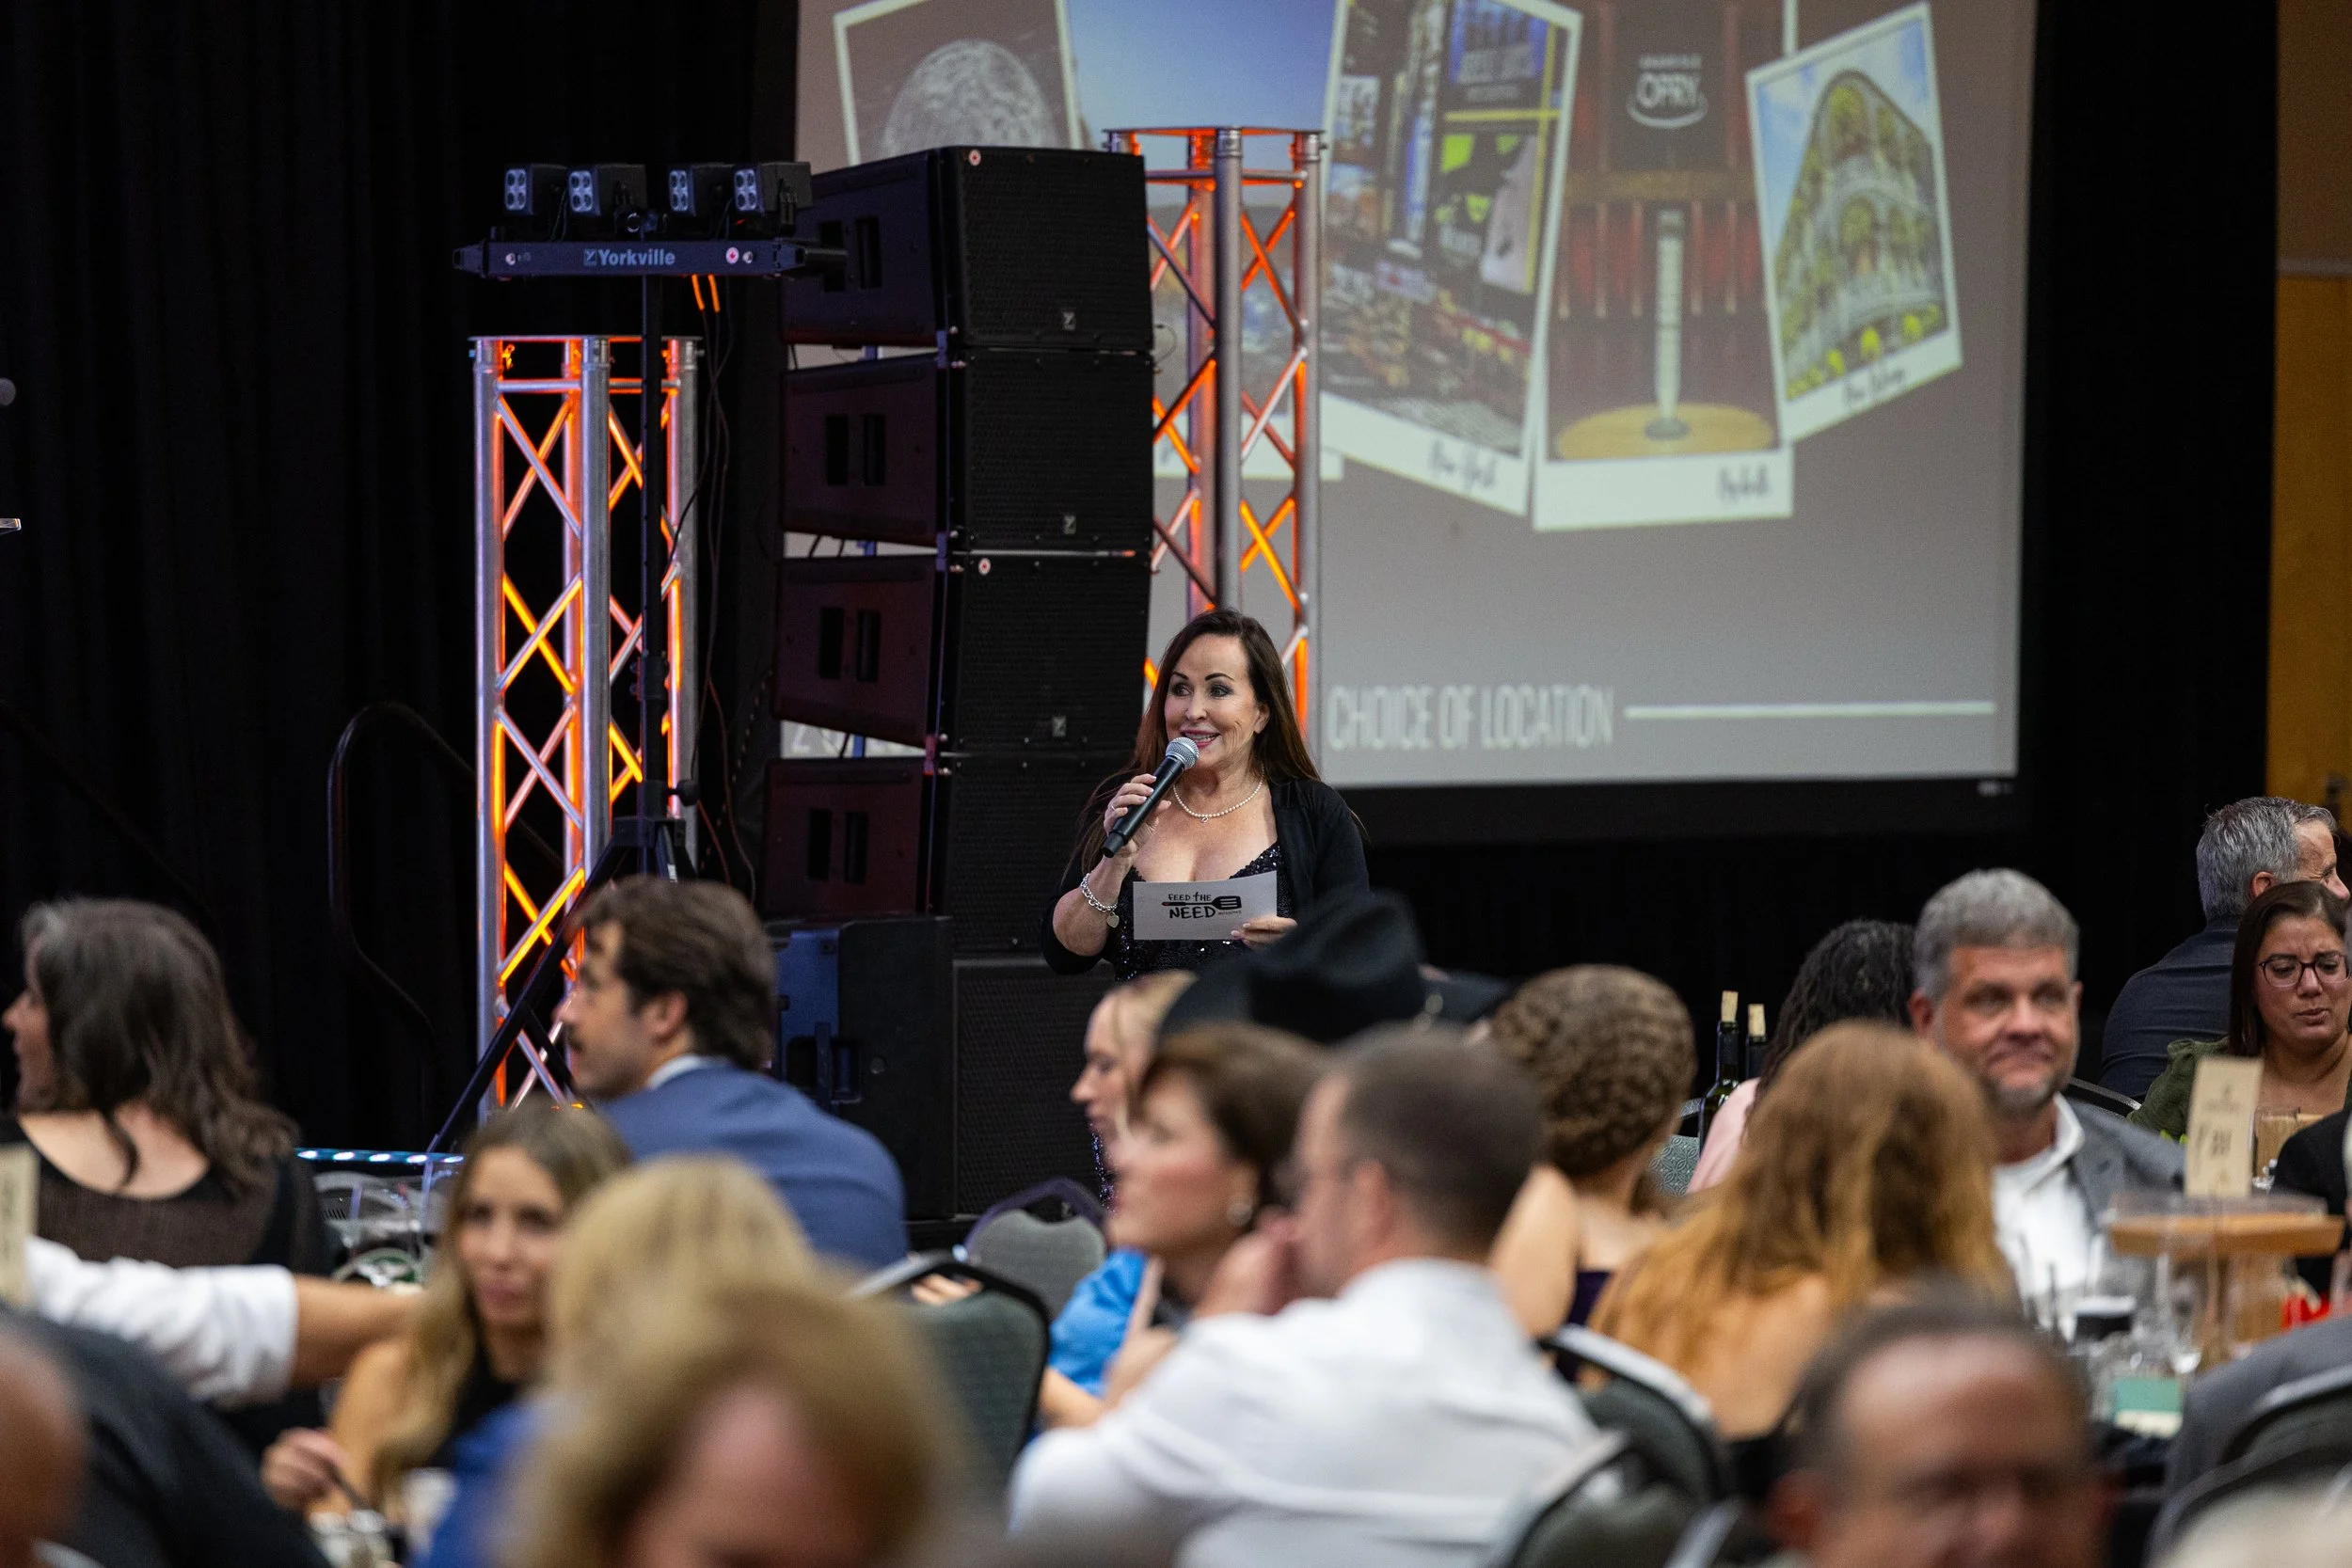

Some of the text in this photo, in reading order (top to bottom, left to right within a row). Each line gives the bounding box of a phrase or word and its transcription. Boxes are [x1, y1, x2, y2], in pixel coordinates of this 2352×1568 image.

[597, 248, 676, 266] Yorkville
[1326, 683, 1614, 750] CHOICE OF LOCATION
[1168, 893, 1191, 901] FEED
[1168, 906, 1216, 919] NEED
